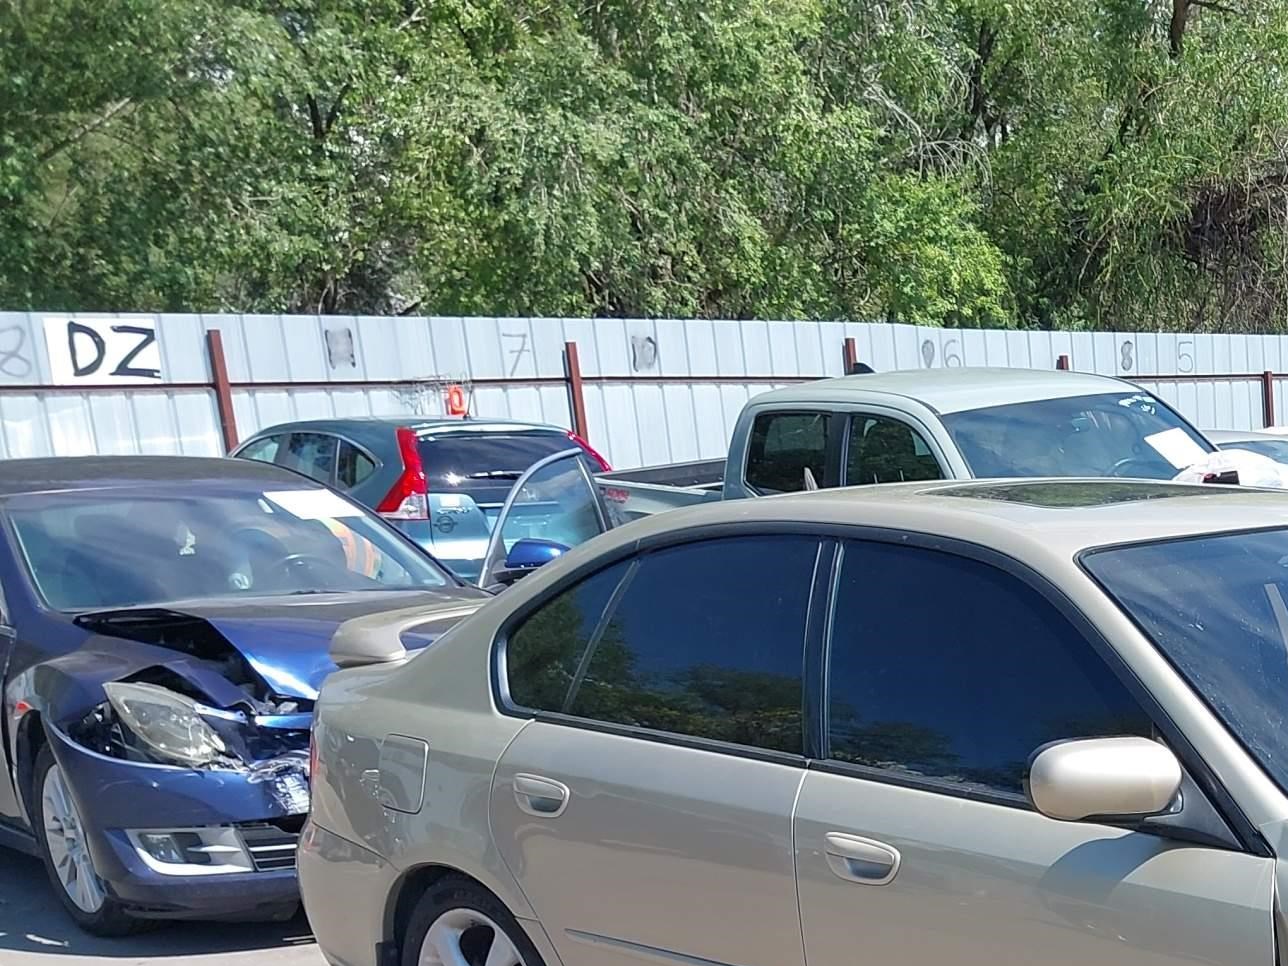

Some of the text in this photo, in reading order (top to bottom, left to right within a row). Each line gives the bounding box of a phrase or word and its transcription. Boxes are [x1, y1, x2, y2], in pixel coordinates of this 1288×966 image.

[67, 321, 161, 378] DZ
[502, 332, 530, 377] 7
[1178, 341, 1194, 373] 5
